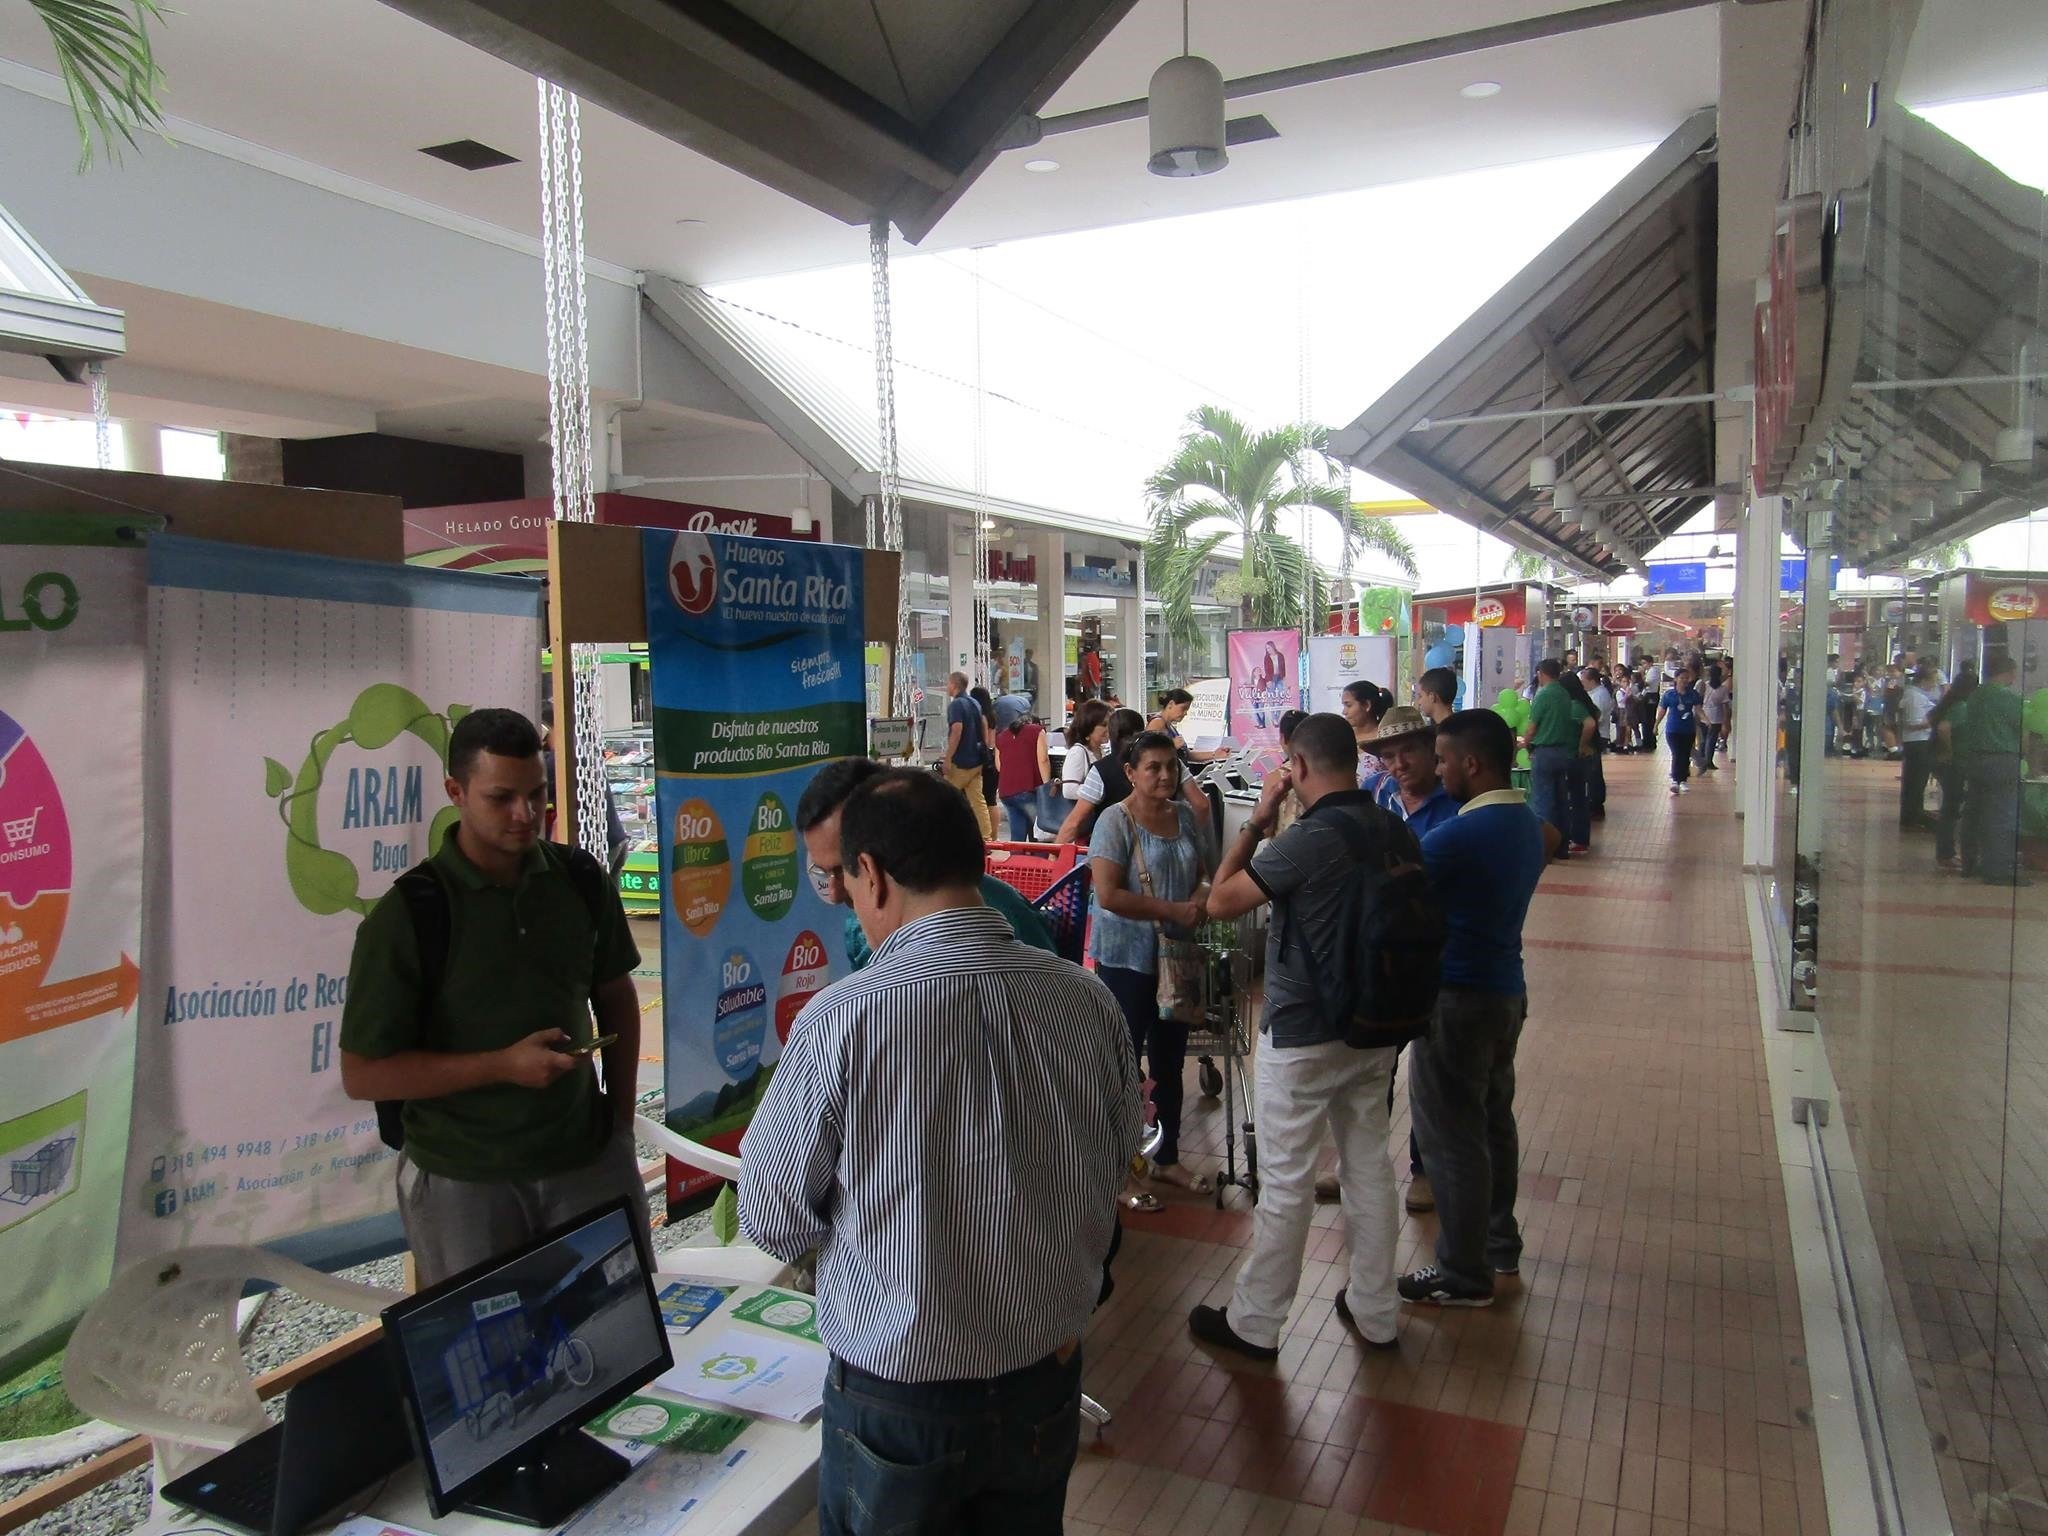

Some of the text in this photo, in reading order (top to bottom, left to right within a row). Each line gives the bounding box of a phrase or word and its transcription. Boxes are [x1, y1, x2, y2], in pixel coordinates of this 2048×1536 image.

[446, 519, 502, 535] HELADO
[725, 541, 785, 566] Huevos
[722, 568, 849, 610] Santa Rita
[735, 607, 764, 621] huevo
[766, 610, 799, 623] nuestro
[712, 719, 819, 742] Disfruta de nuestros
[693, 740, 830, 770] productos Bio Santa Rita
[343, 766, 422, 829] ARAM
[0, 843, 50, 864] ONSUMO
[372, 839, 408, 873] Buga
[795, 974, 816, 990] Rojo
[163, 973, 347, 1025] Asociación de Rec
[718, 985, 765, 1017] Saludable
[310, 1021, 333, 1074] El
[169, 1151, 193, 1173] 318
[202, 1145, 228, 1164] 494
[237, 1140, 272, 1158] 9948
[294, 1132, 318, 1151] 318
[324, 1125, 348, 1143] 697
[352, 1118, 379, 1136] 890
[183, 1180, 216, 1206] ARAM
[237, 1168, 304, 1192] Asociación
[310, 1161, 323, 1177] de
